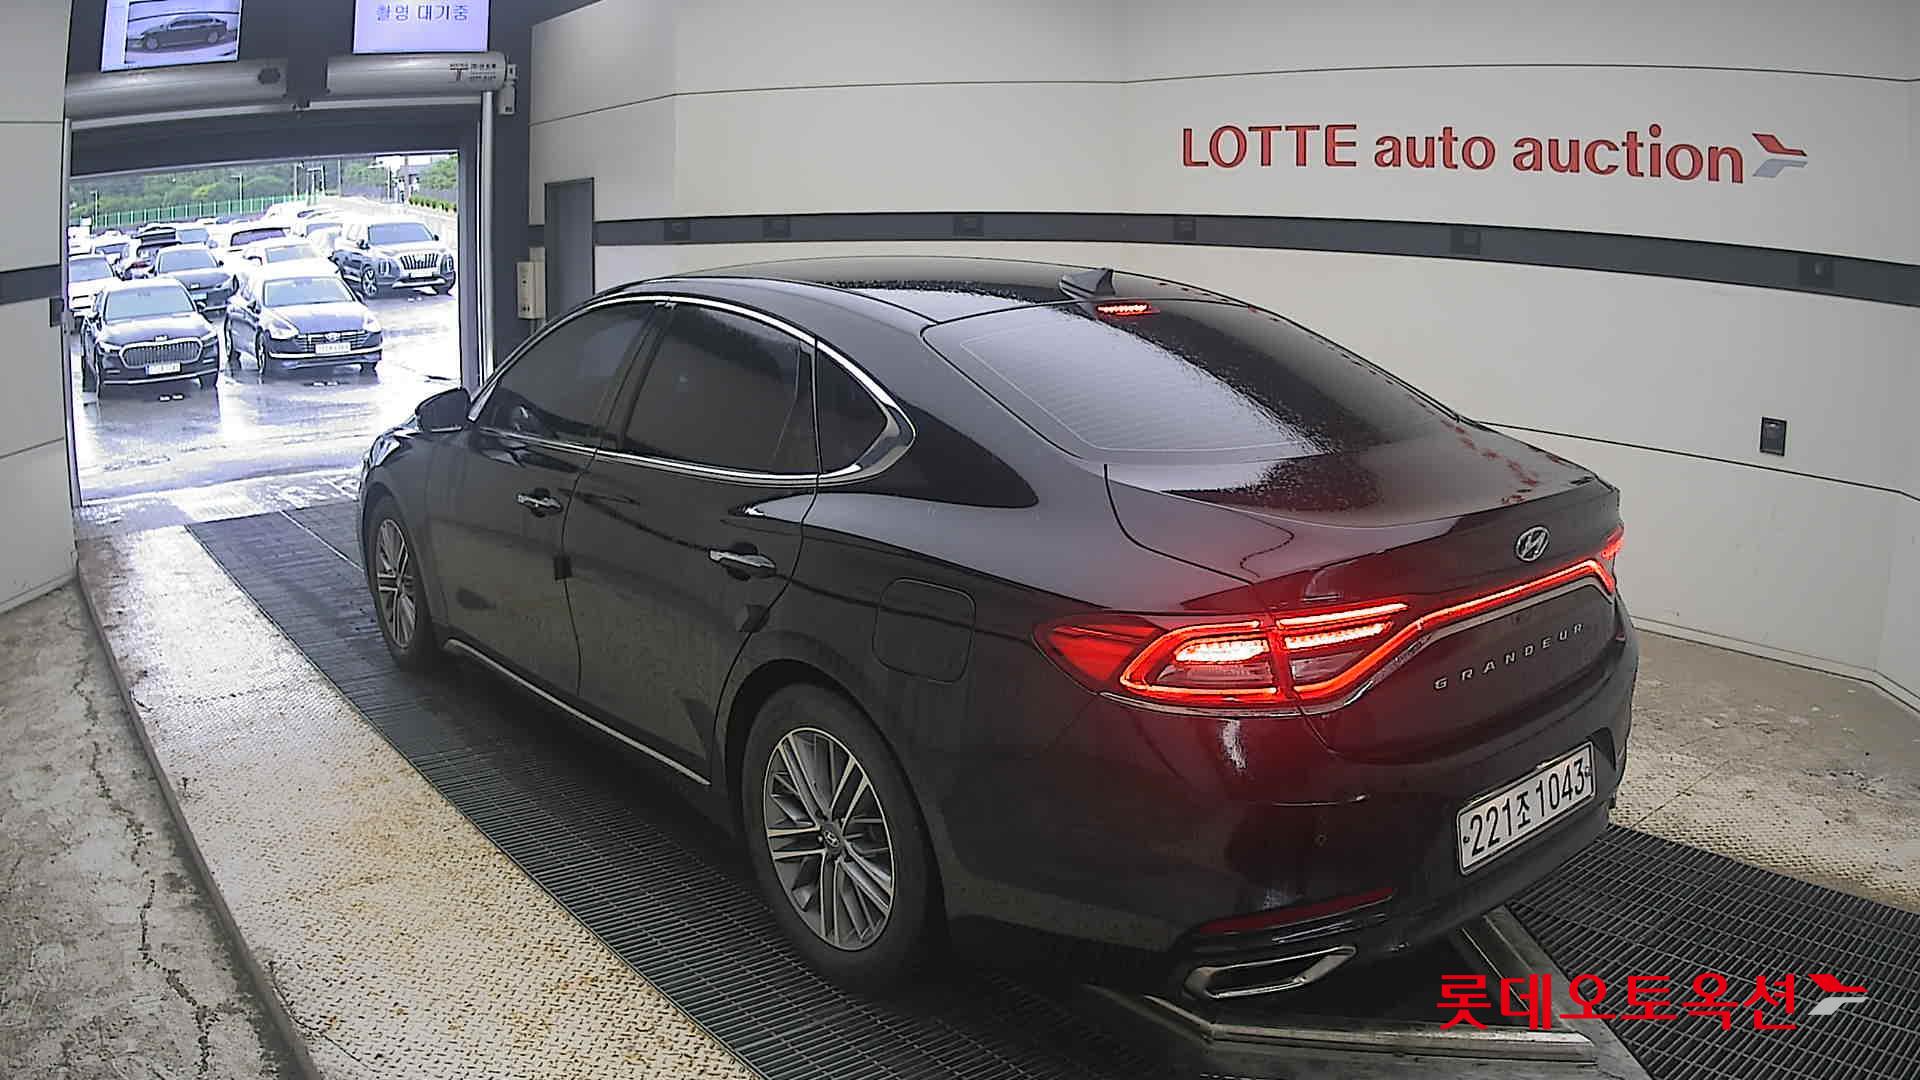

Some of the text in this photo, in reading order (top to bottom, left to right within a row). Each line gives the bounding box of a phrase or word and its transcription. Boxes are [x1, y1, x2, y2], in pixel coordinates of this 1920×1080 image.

[417, 4, 469, 21] 대기중
[1182, 123, 1744, 184] LOTTE auto auction
[1433, 622, 1585, 691] GRANDEUR
[1469, 756, 1586, 857] 221조 1043
